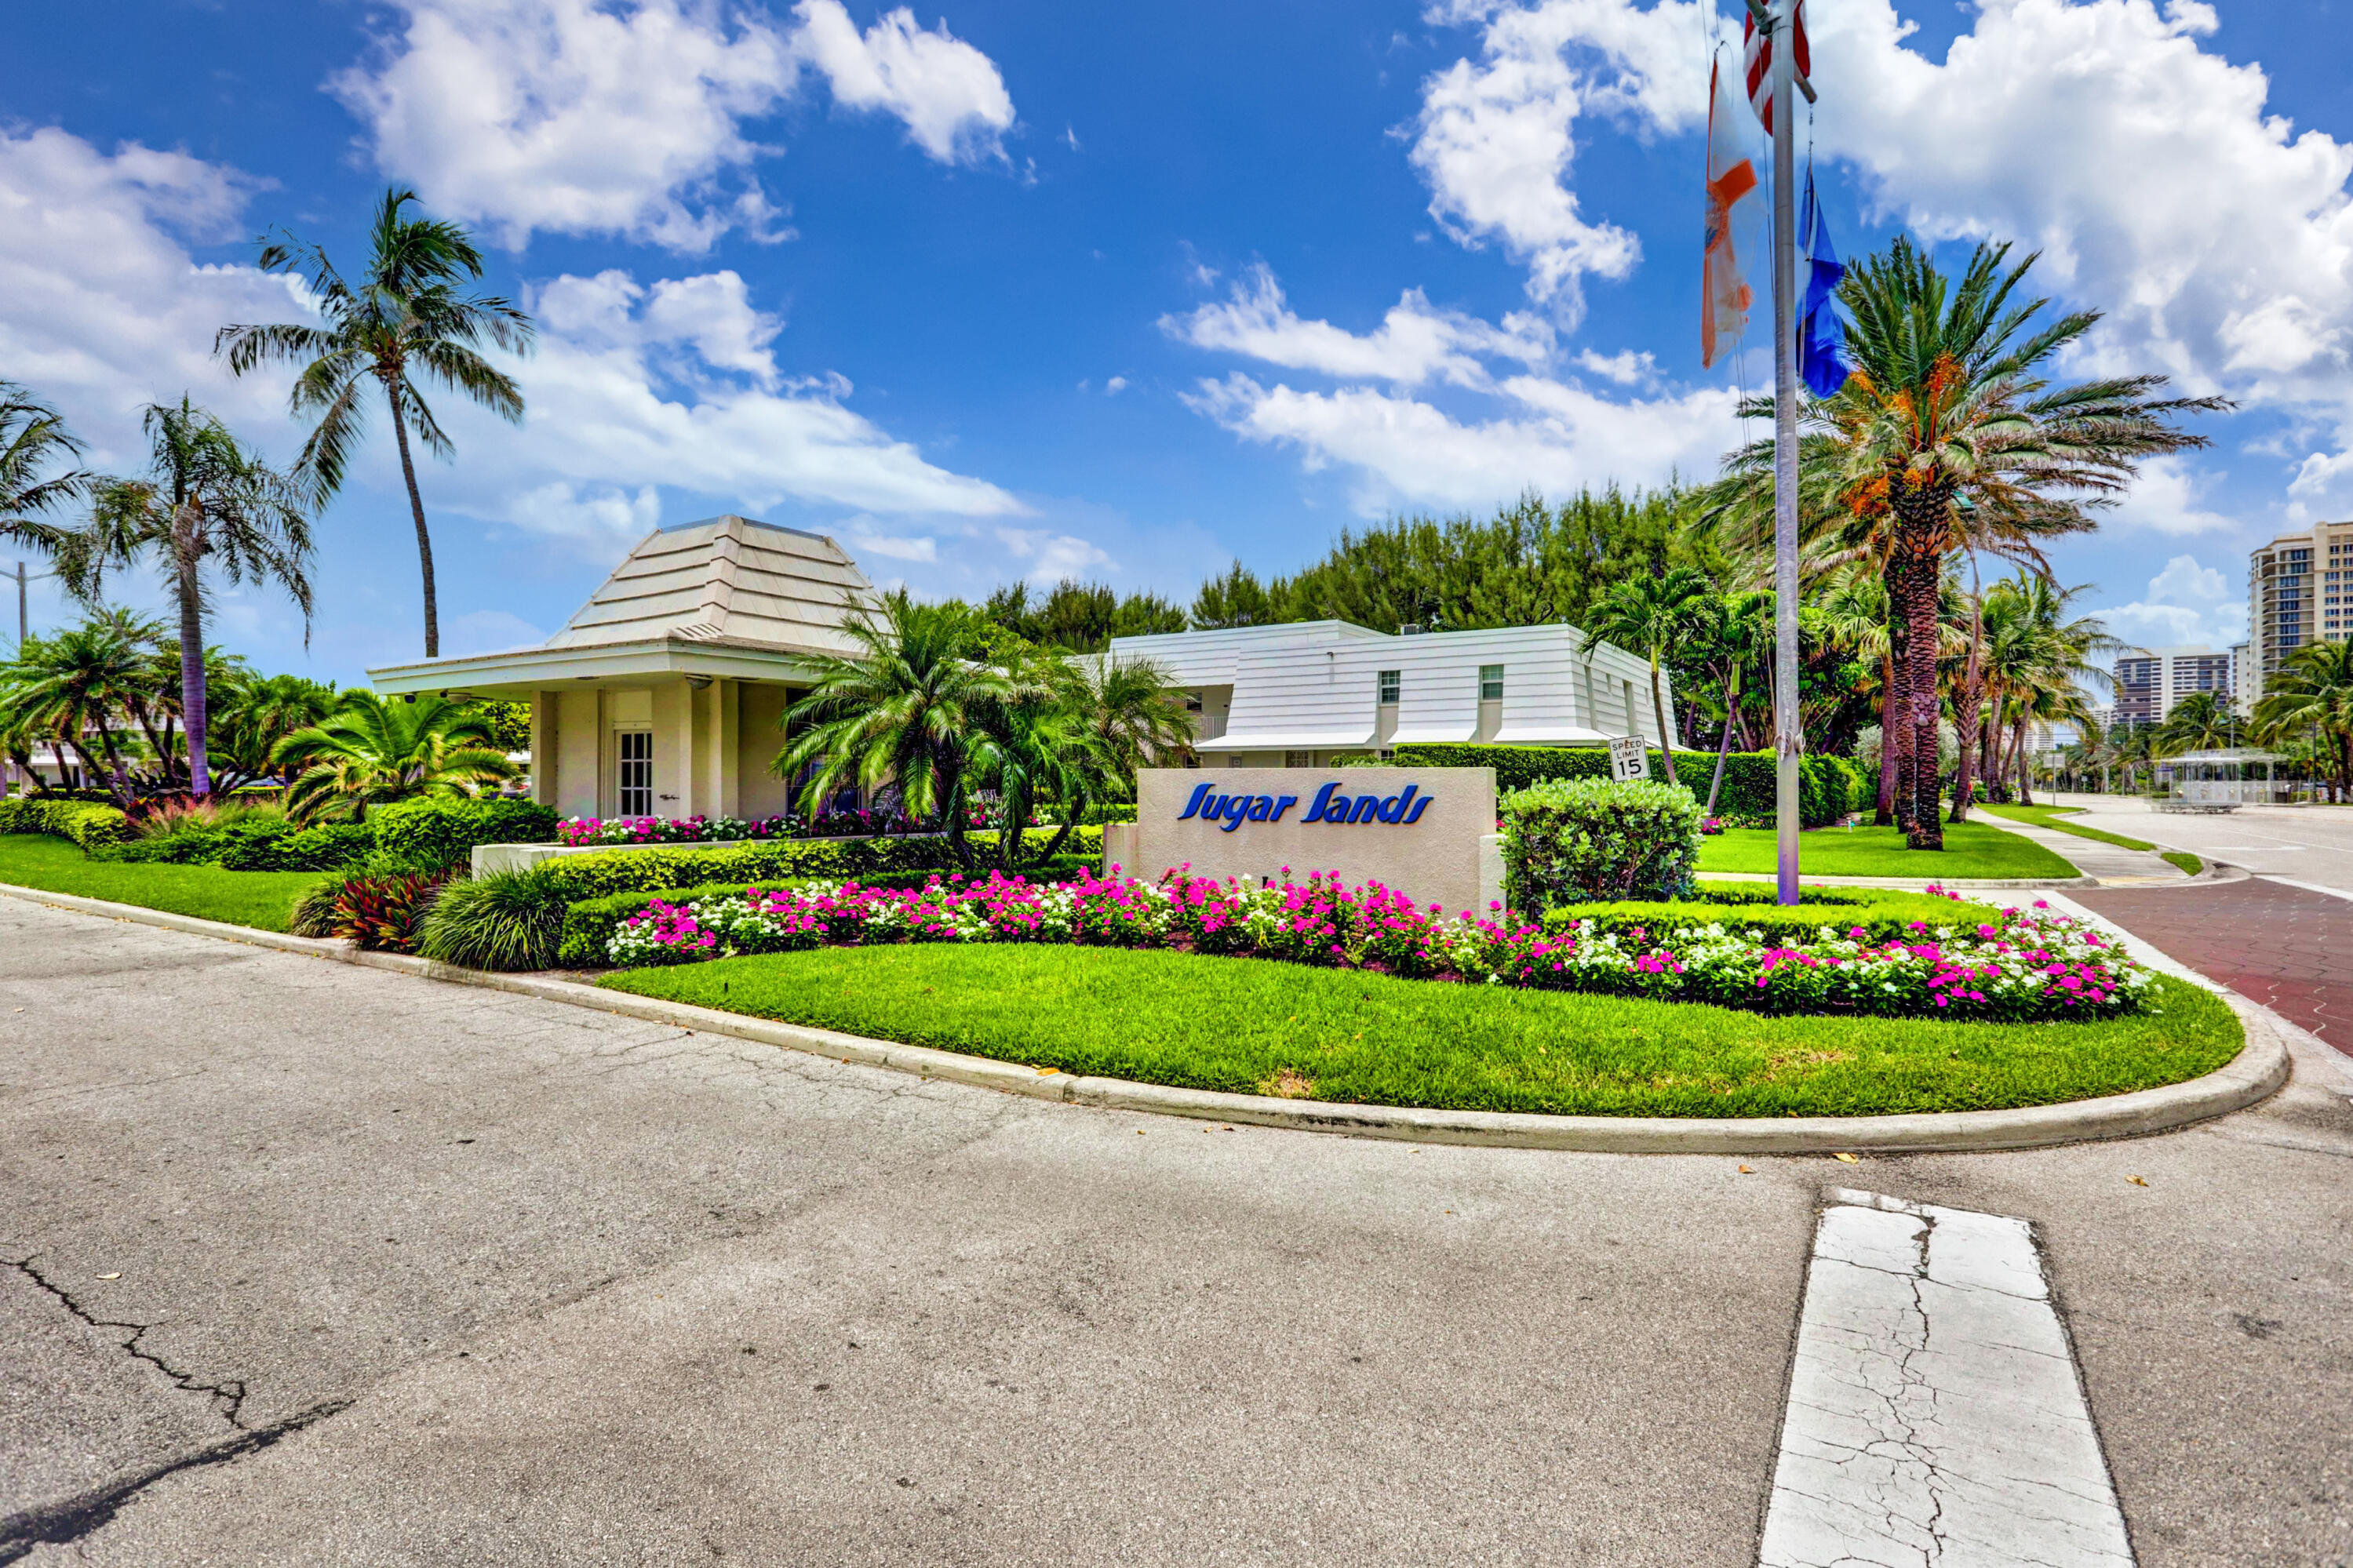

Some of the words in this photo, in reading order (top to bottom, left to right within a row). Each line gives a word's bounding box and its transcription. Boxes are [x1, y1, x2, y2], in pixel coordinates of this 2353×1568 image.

[1612, 740, 1641, 751] SPEED
[1617, 750, 1639, 759] LIMIT
[1619, 759, 1641, 776] 15
[1177, 783, 1298, 832] Sugar
[1300, 782, 1434, 824] Sands
